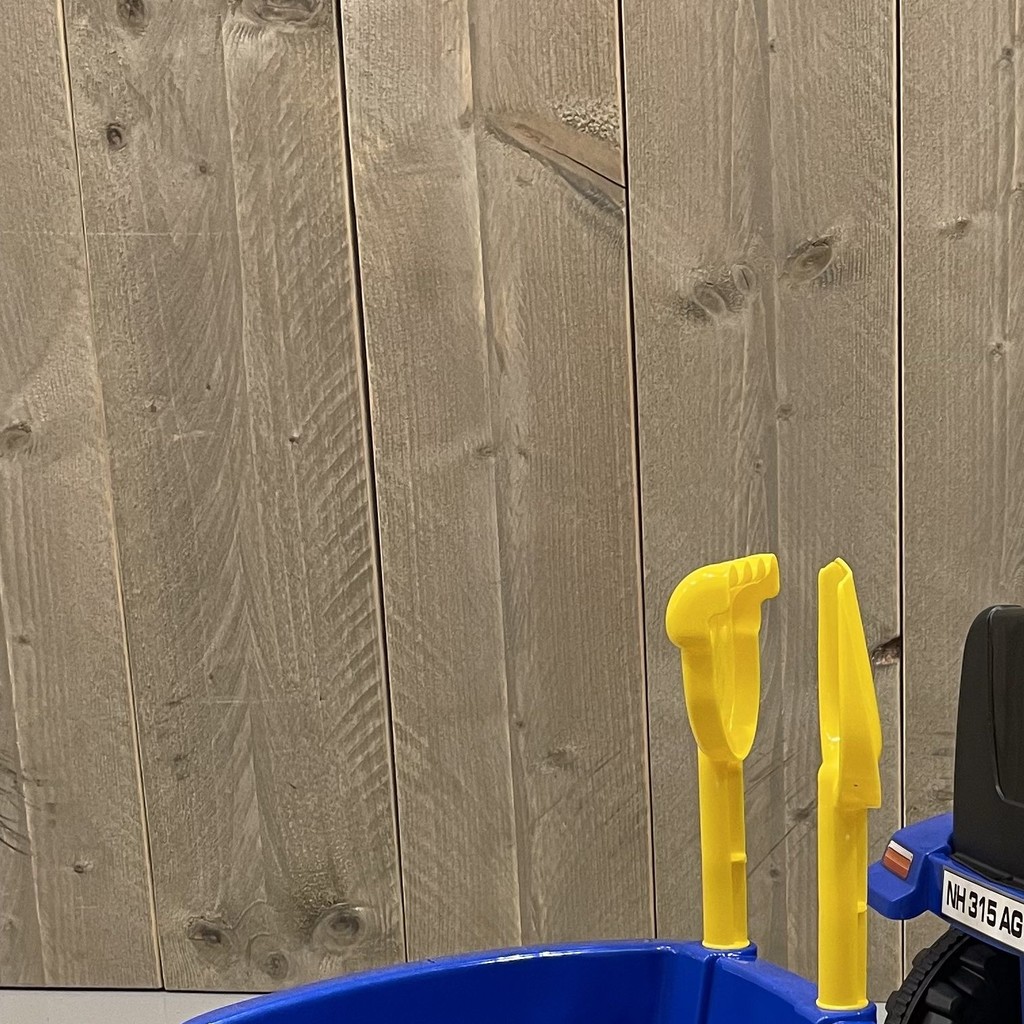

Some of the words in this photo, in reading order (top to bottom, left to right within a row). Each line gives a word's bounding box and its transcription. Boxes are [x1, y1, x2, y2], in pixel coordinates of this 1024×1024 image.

[946, 880, 966, 913] NH
[969, 891, 997, 927] 315
[999, 906, 1023, 938] AG
